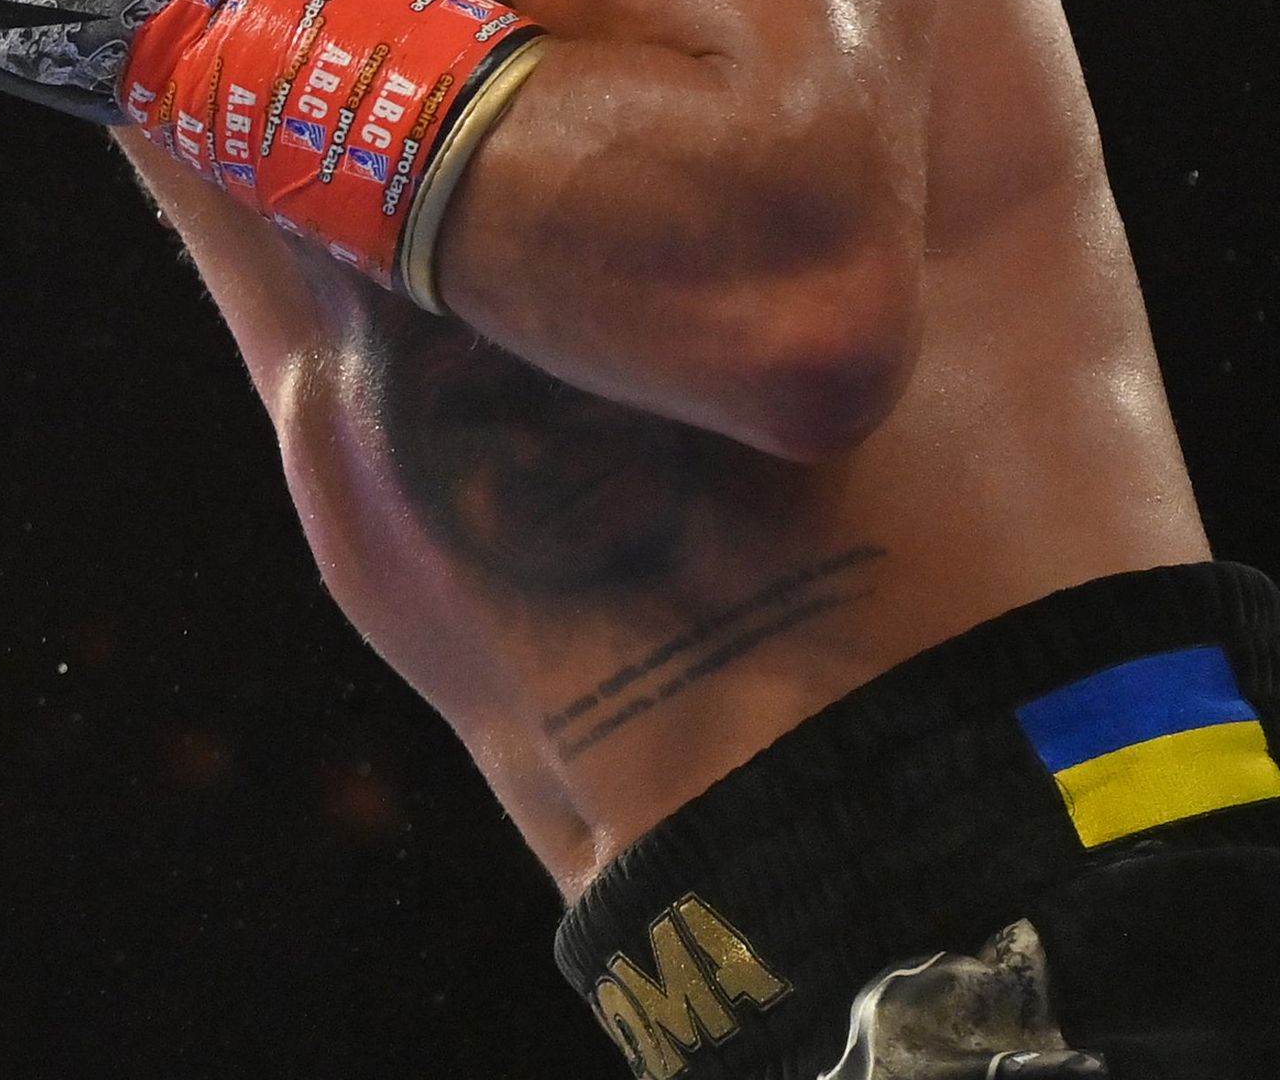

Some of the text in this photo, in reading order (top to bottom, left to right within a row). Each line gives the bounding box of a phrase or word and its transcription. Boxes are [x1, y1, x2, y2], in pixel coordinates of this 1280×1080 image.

[298, 42, 353, 120] A.B.C
[348, 44, 389, 110] empire
[361, 71, 416, 149] A.B.C
[412, 74, 455, 140] empire
[225, 83, 257, 159] A.B.C
